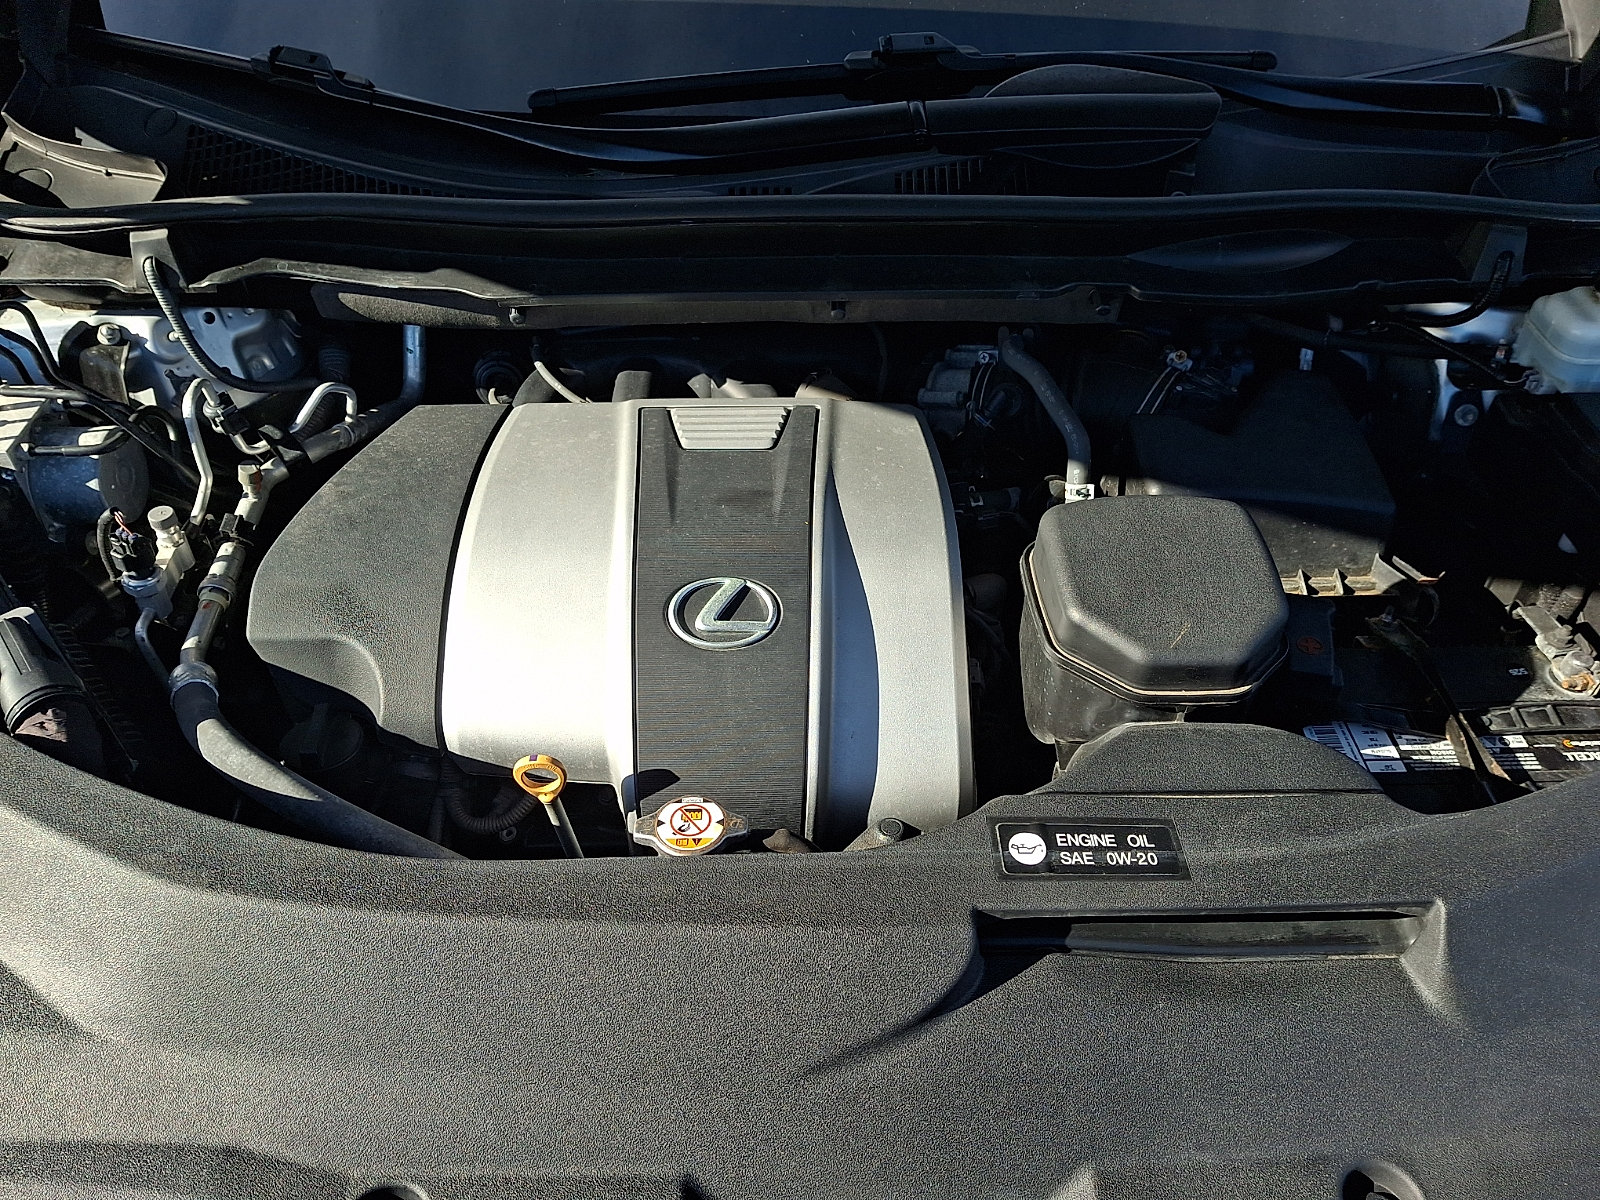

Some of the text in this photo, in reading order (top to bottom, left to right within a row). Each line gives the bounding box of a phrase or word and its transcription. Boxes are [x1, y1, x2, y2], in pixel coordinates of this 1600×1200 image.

[1055, 833, 1156, 848] ENGINE OIL
[1060, 851, 1158, 866] SAE 0W-20
